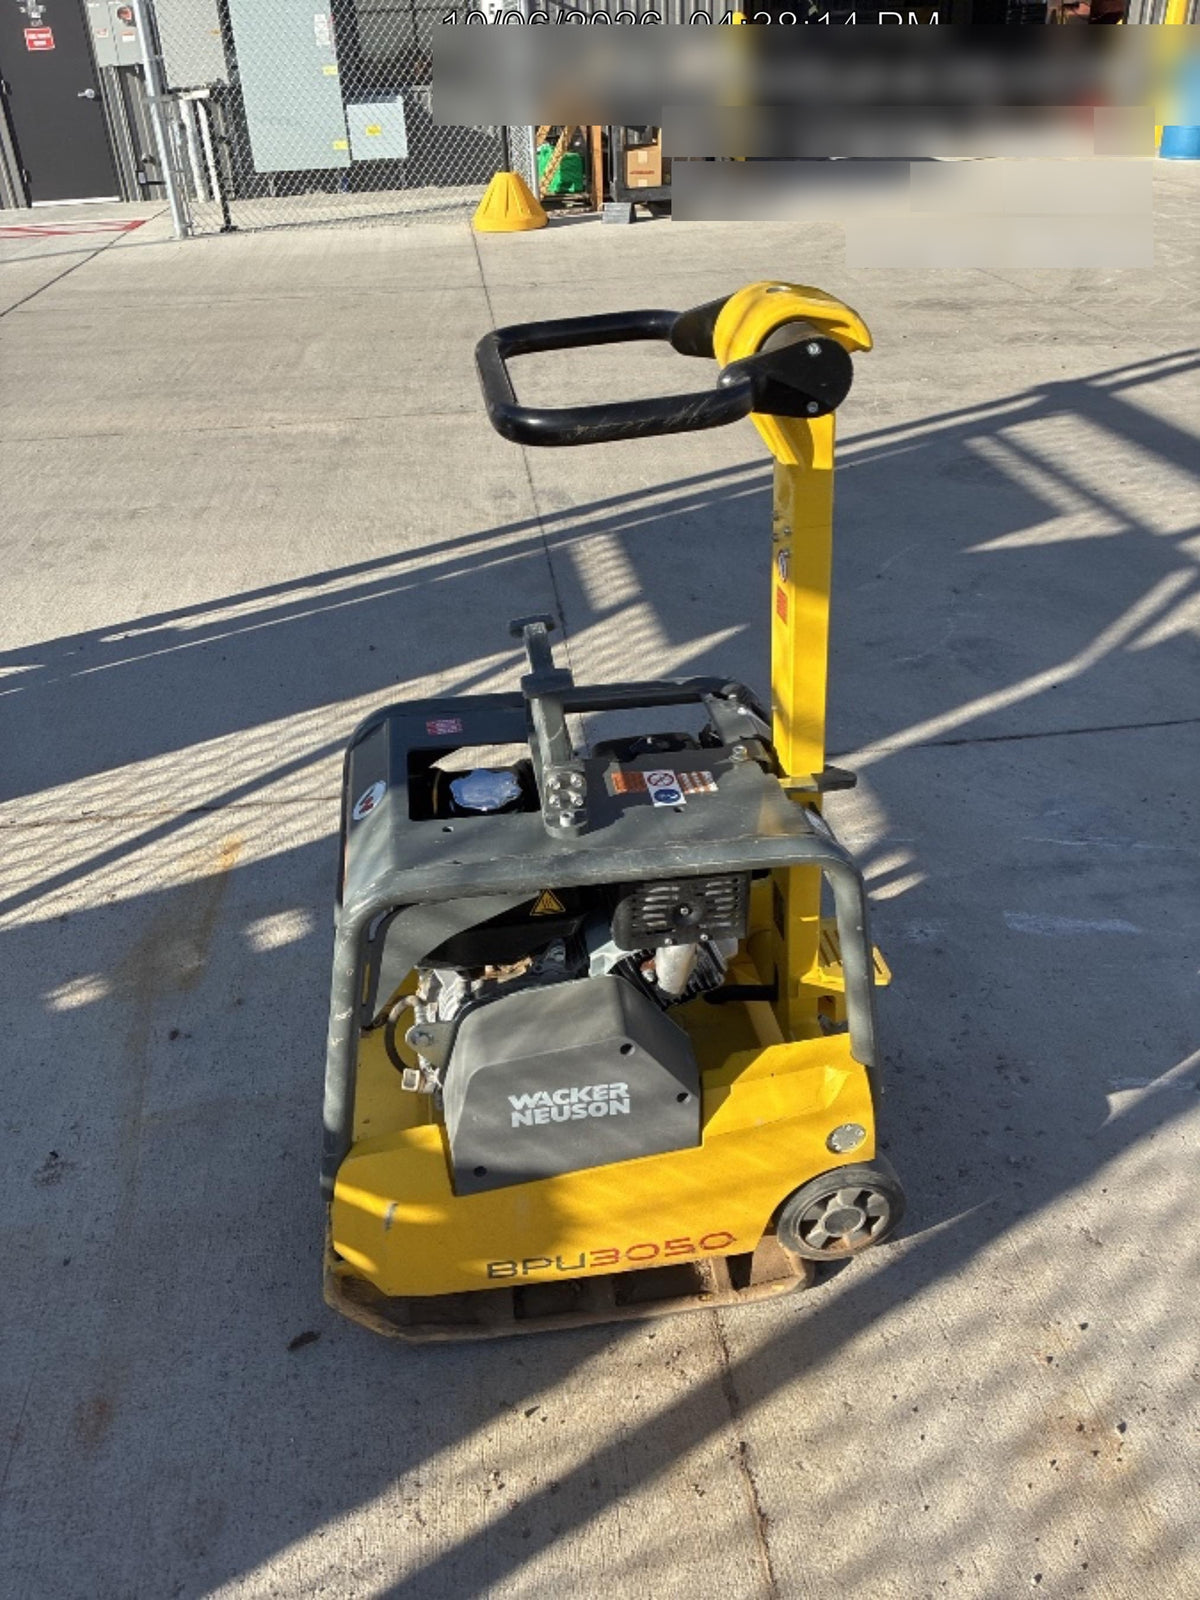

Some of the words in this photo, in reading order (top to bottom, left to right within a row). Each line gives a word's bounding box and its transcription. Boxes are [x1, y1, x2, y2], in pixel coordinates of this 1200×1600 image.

[508, 1082, 630, 1111] WACKER
[511, 1098, 631, 1128] NEUSON
[487, 1231, 736, 1279] BPU3050
